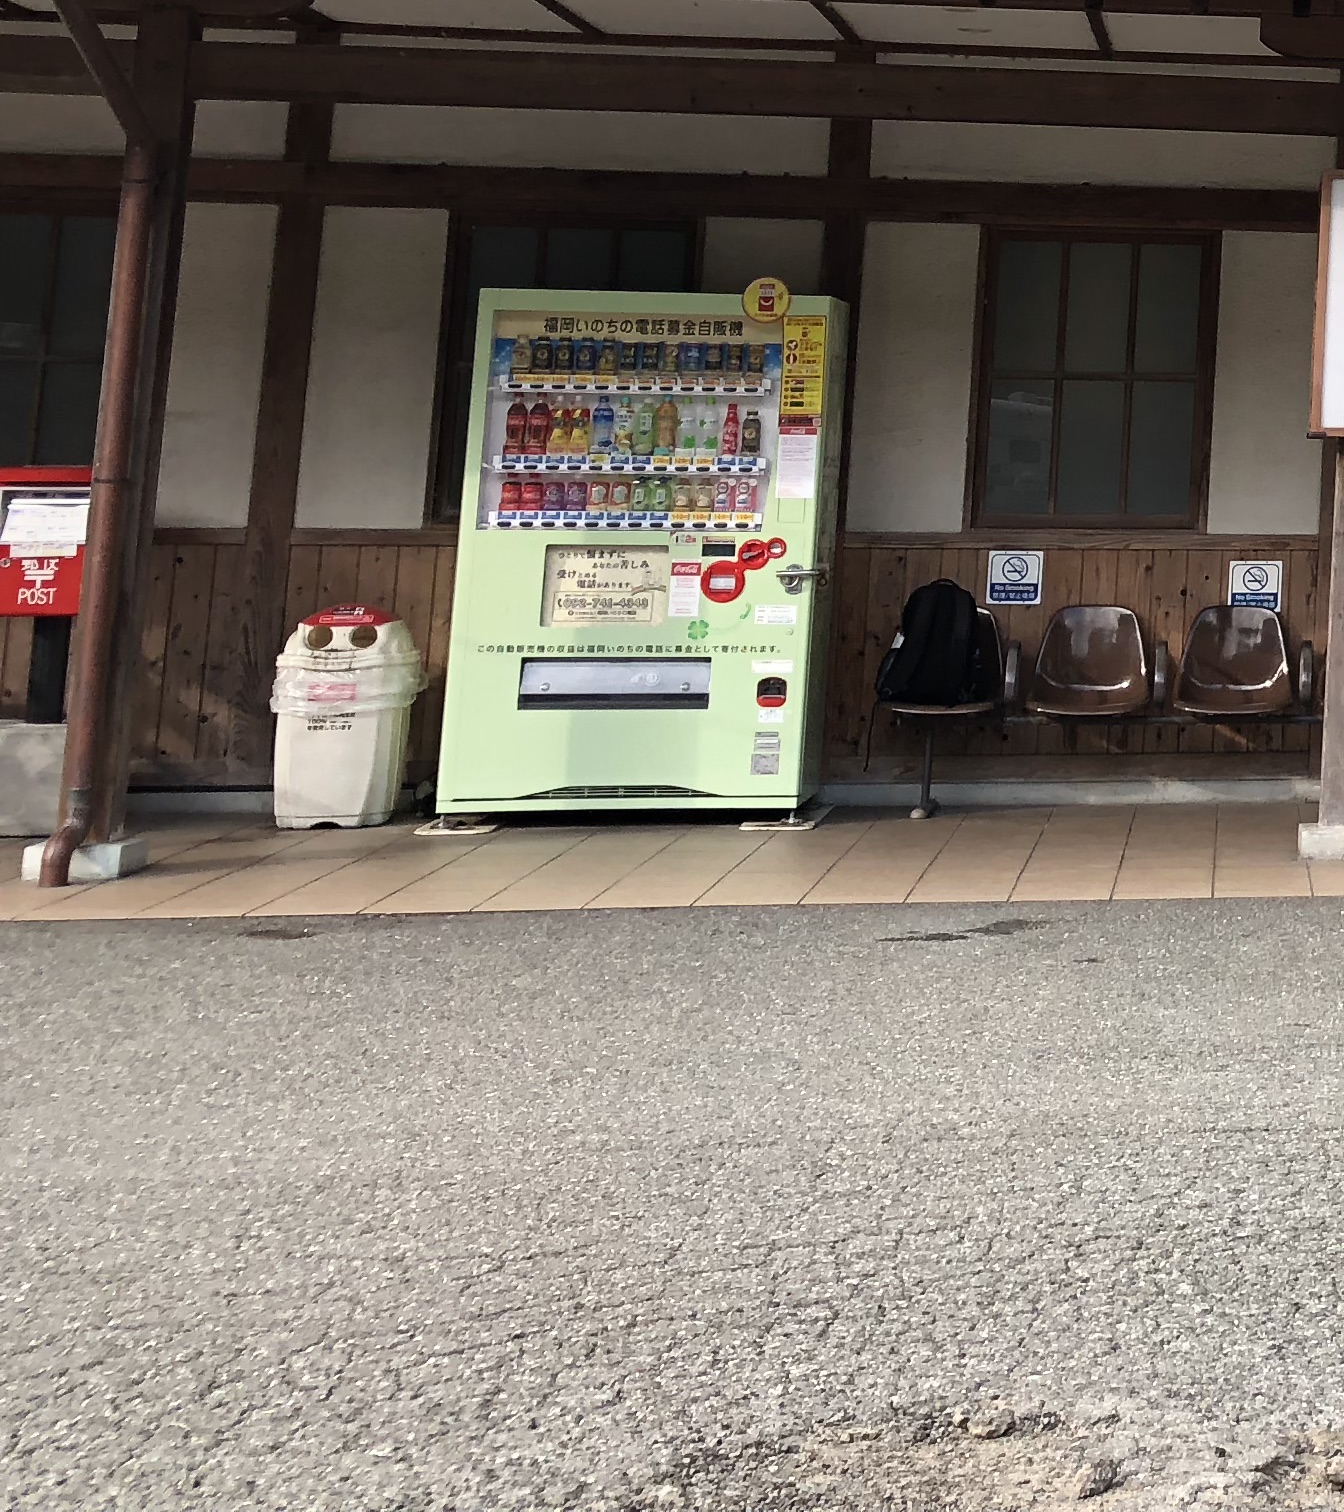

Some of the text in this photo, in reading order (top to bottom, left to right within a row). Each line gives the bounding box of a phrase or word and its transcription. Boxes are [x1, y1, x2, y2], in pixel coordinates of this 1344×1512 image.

[544, 316, 744, 337] 福岡いのちの電話募金自販機
[17, 587, 58, 605] POST
